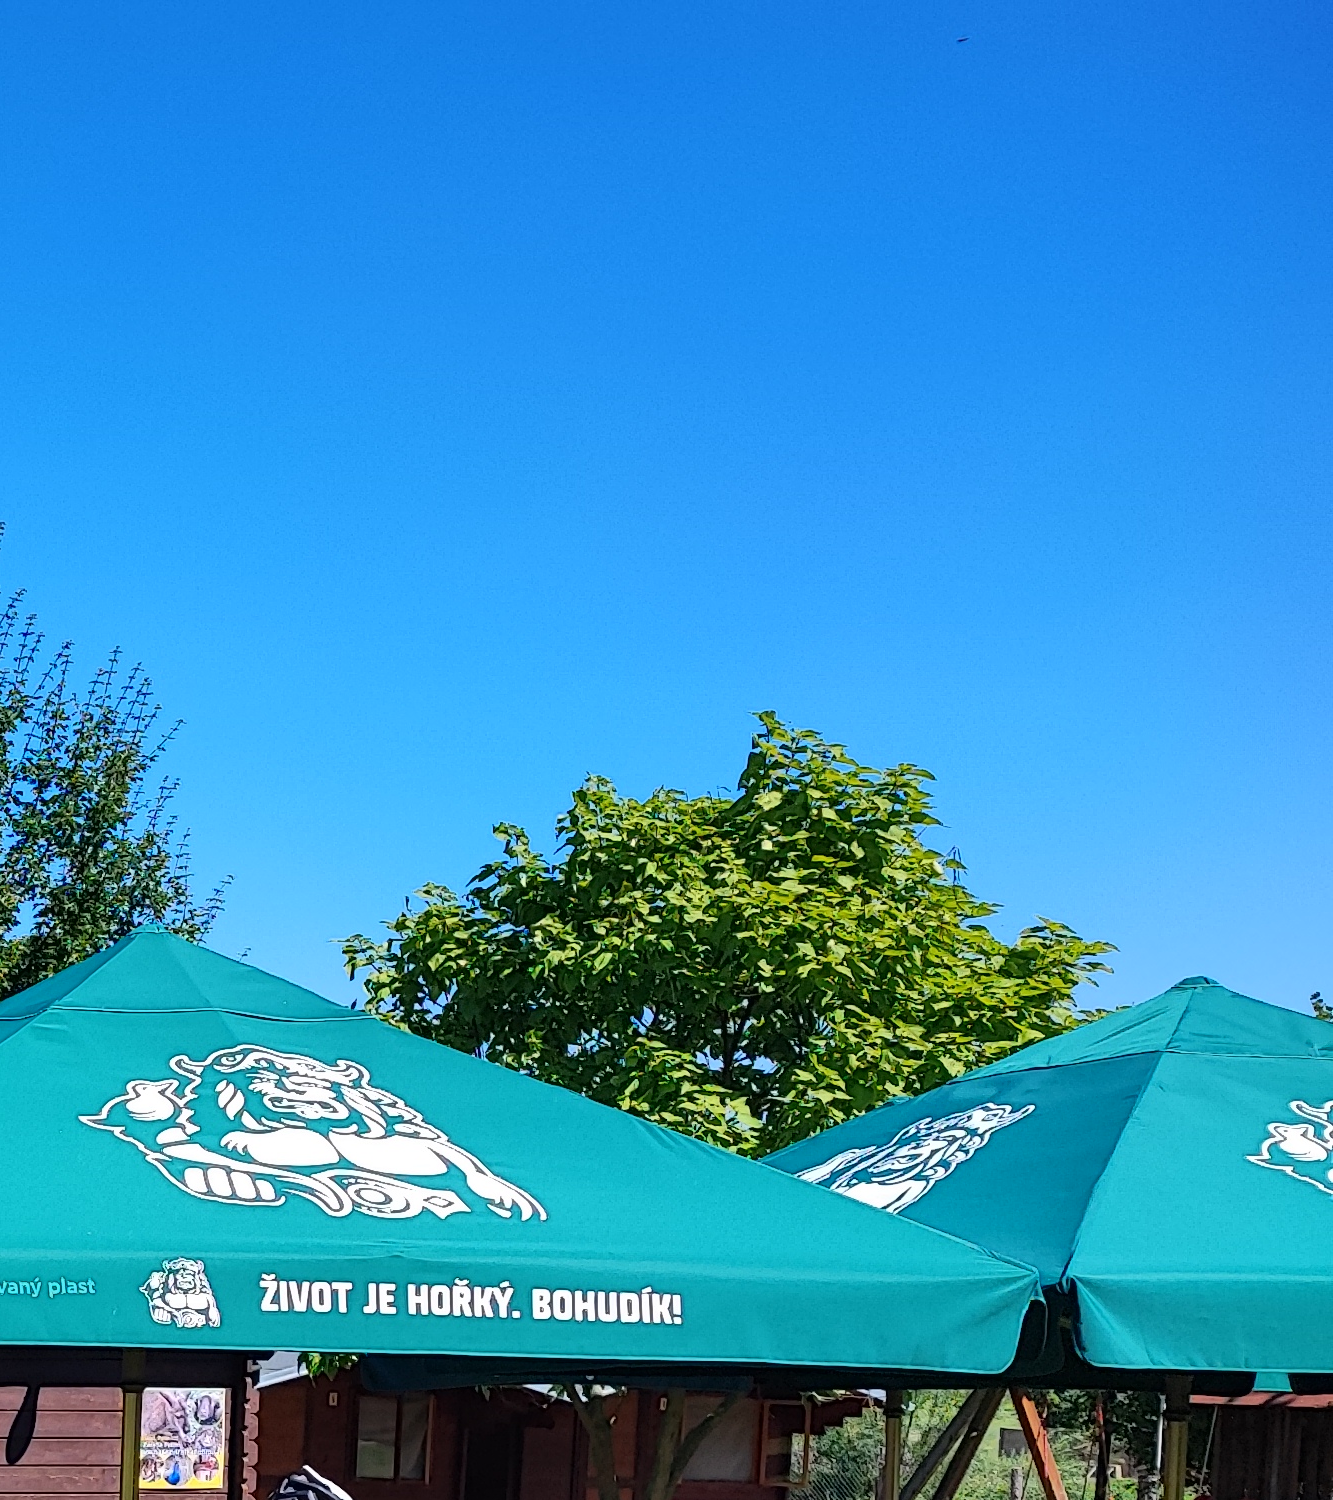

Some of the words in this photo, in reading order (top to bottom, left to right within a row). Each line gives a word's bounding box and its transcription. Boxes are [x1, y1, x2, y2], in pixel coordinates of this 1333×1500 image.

[48, 1276, 96, 1299] plast
[259, 1273, 352, 1313] ŽIVOT
[363, 1282, 396, 1316] JE
[407, 1277, 521, 1320] HOŘKÝ.
[532, 1285, 683, 1325] BOHUDÍK!
